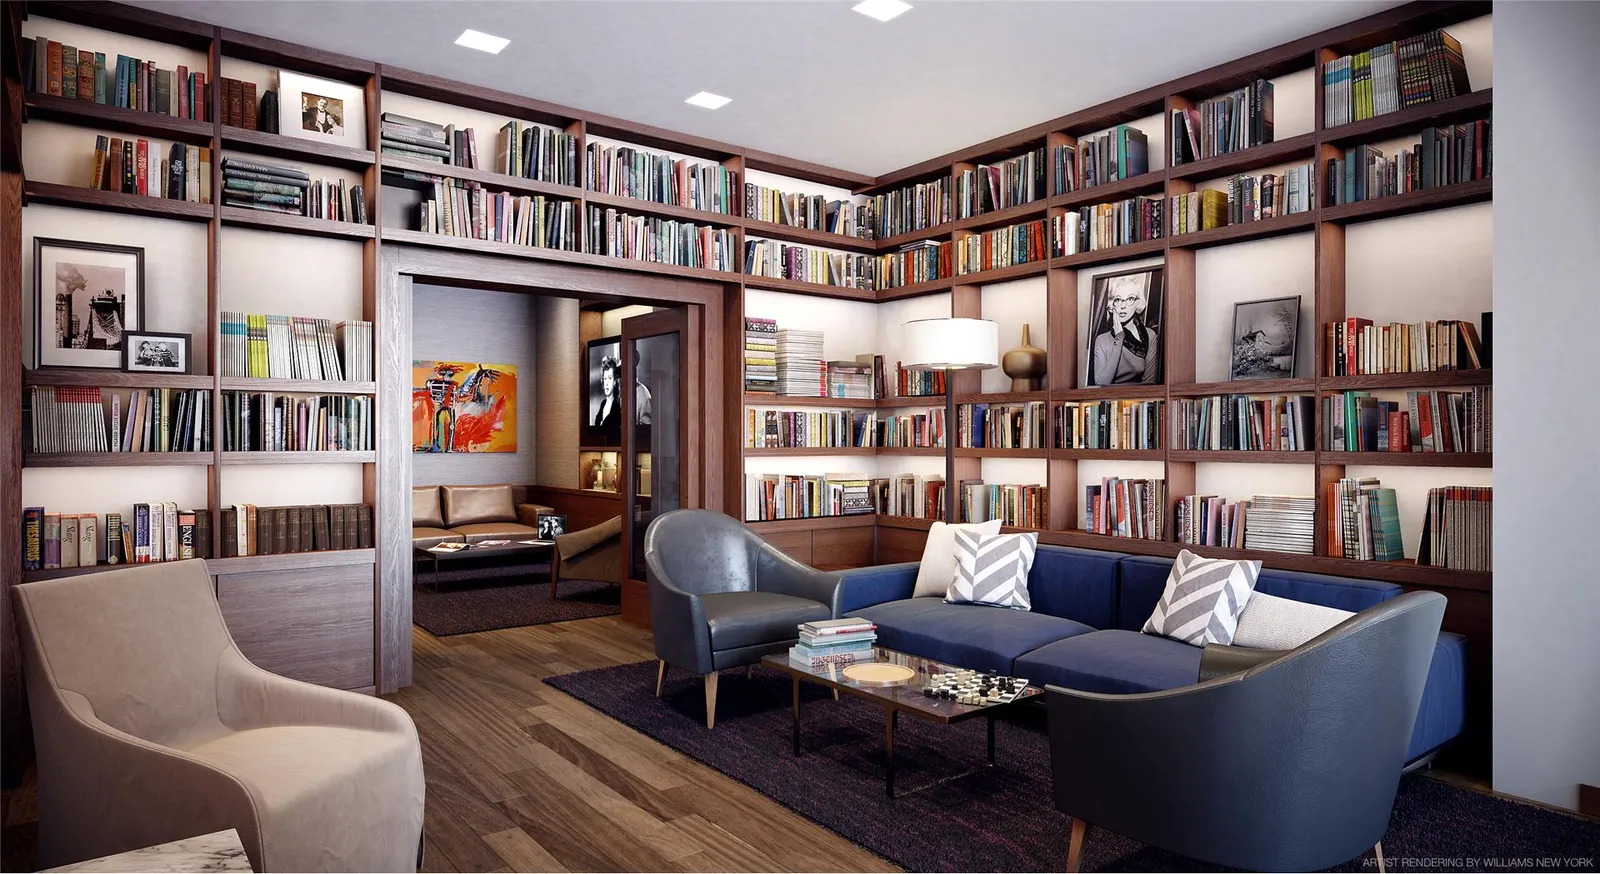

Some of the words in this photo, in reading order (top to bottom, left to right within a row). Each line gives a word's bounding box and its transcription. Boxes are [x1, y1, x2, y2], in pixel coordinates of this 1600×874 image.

[26, 520, 40, 561] THESAURUS
[63, 525, 76, 543] Slang
[82, 525, 95, 542] Slang
[182, 525, 192, 560] ENGLISH
